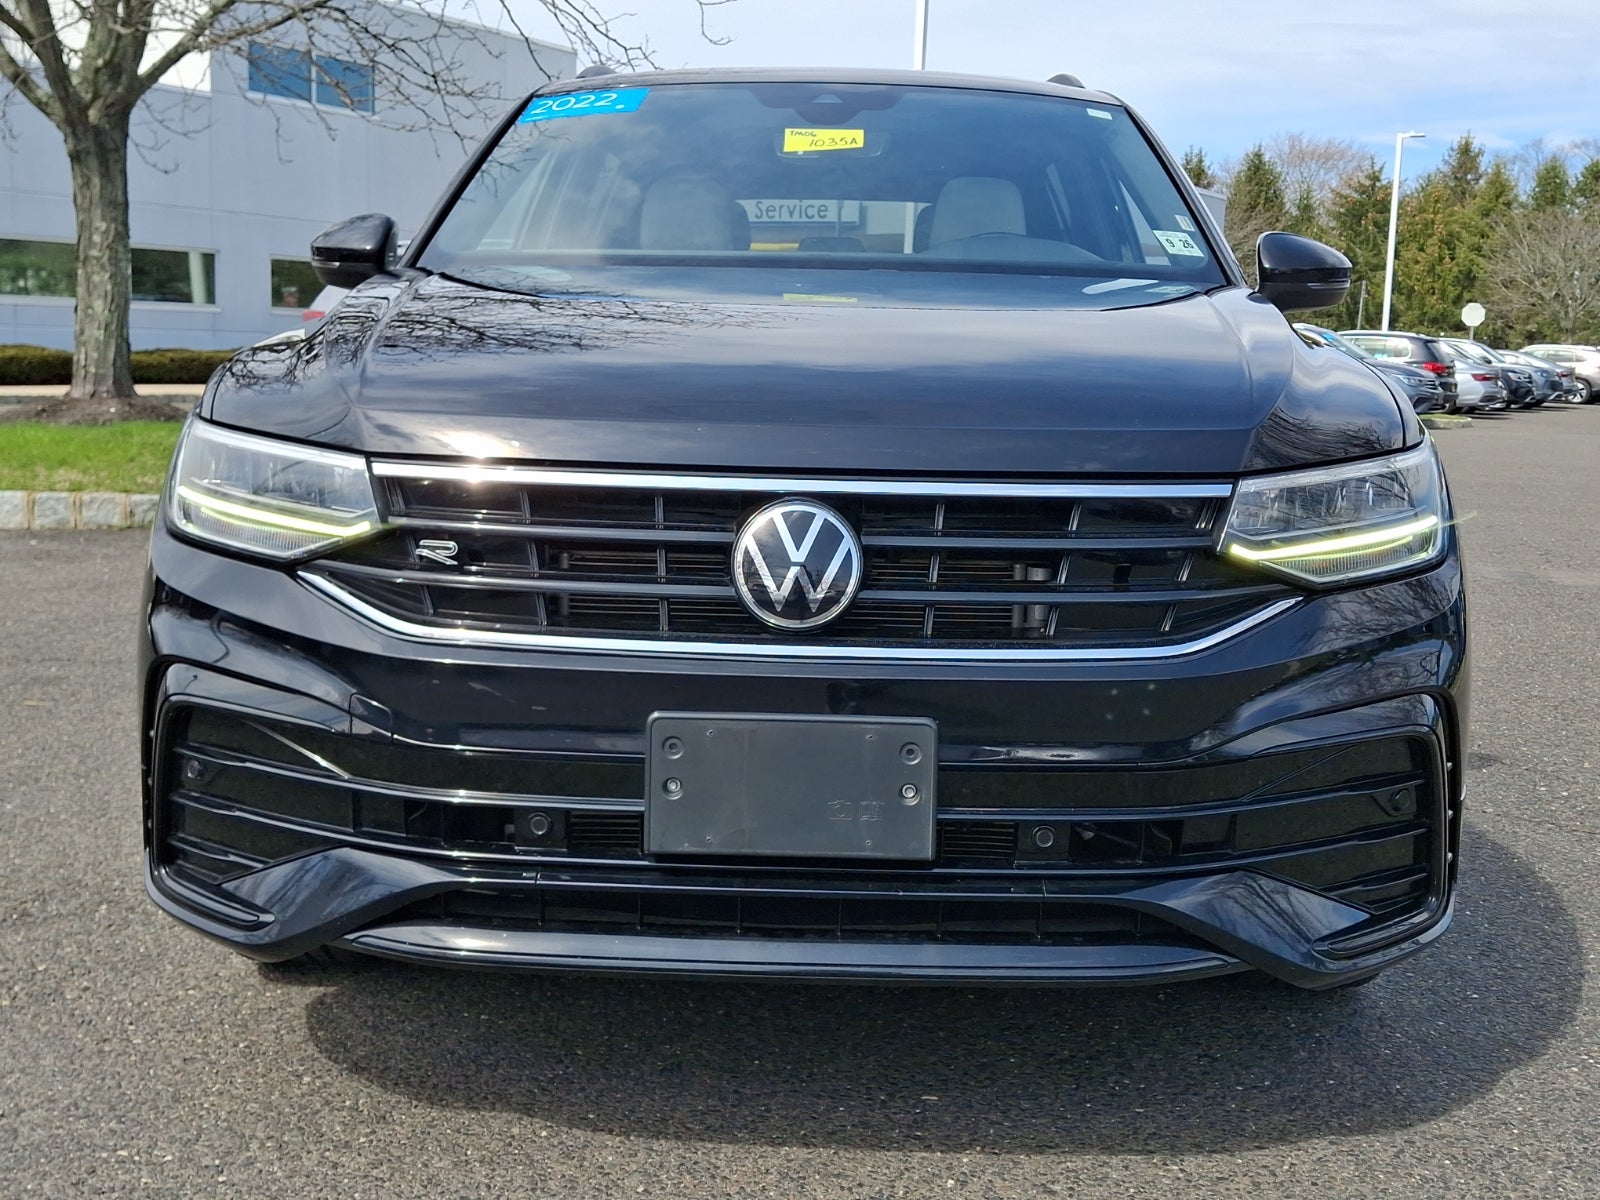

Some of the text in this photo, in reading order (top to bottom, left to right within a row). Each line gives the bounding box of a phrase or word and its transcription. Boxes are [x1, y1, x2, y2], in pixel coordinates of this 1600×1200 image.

[809, 137, 858, 147] 1035A
[755, 200, 829, 220] Service
[1165, 238, 1195, 249] 9 26
[415, 539, 459, 565] R
